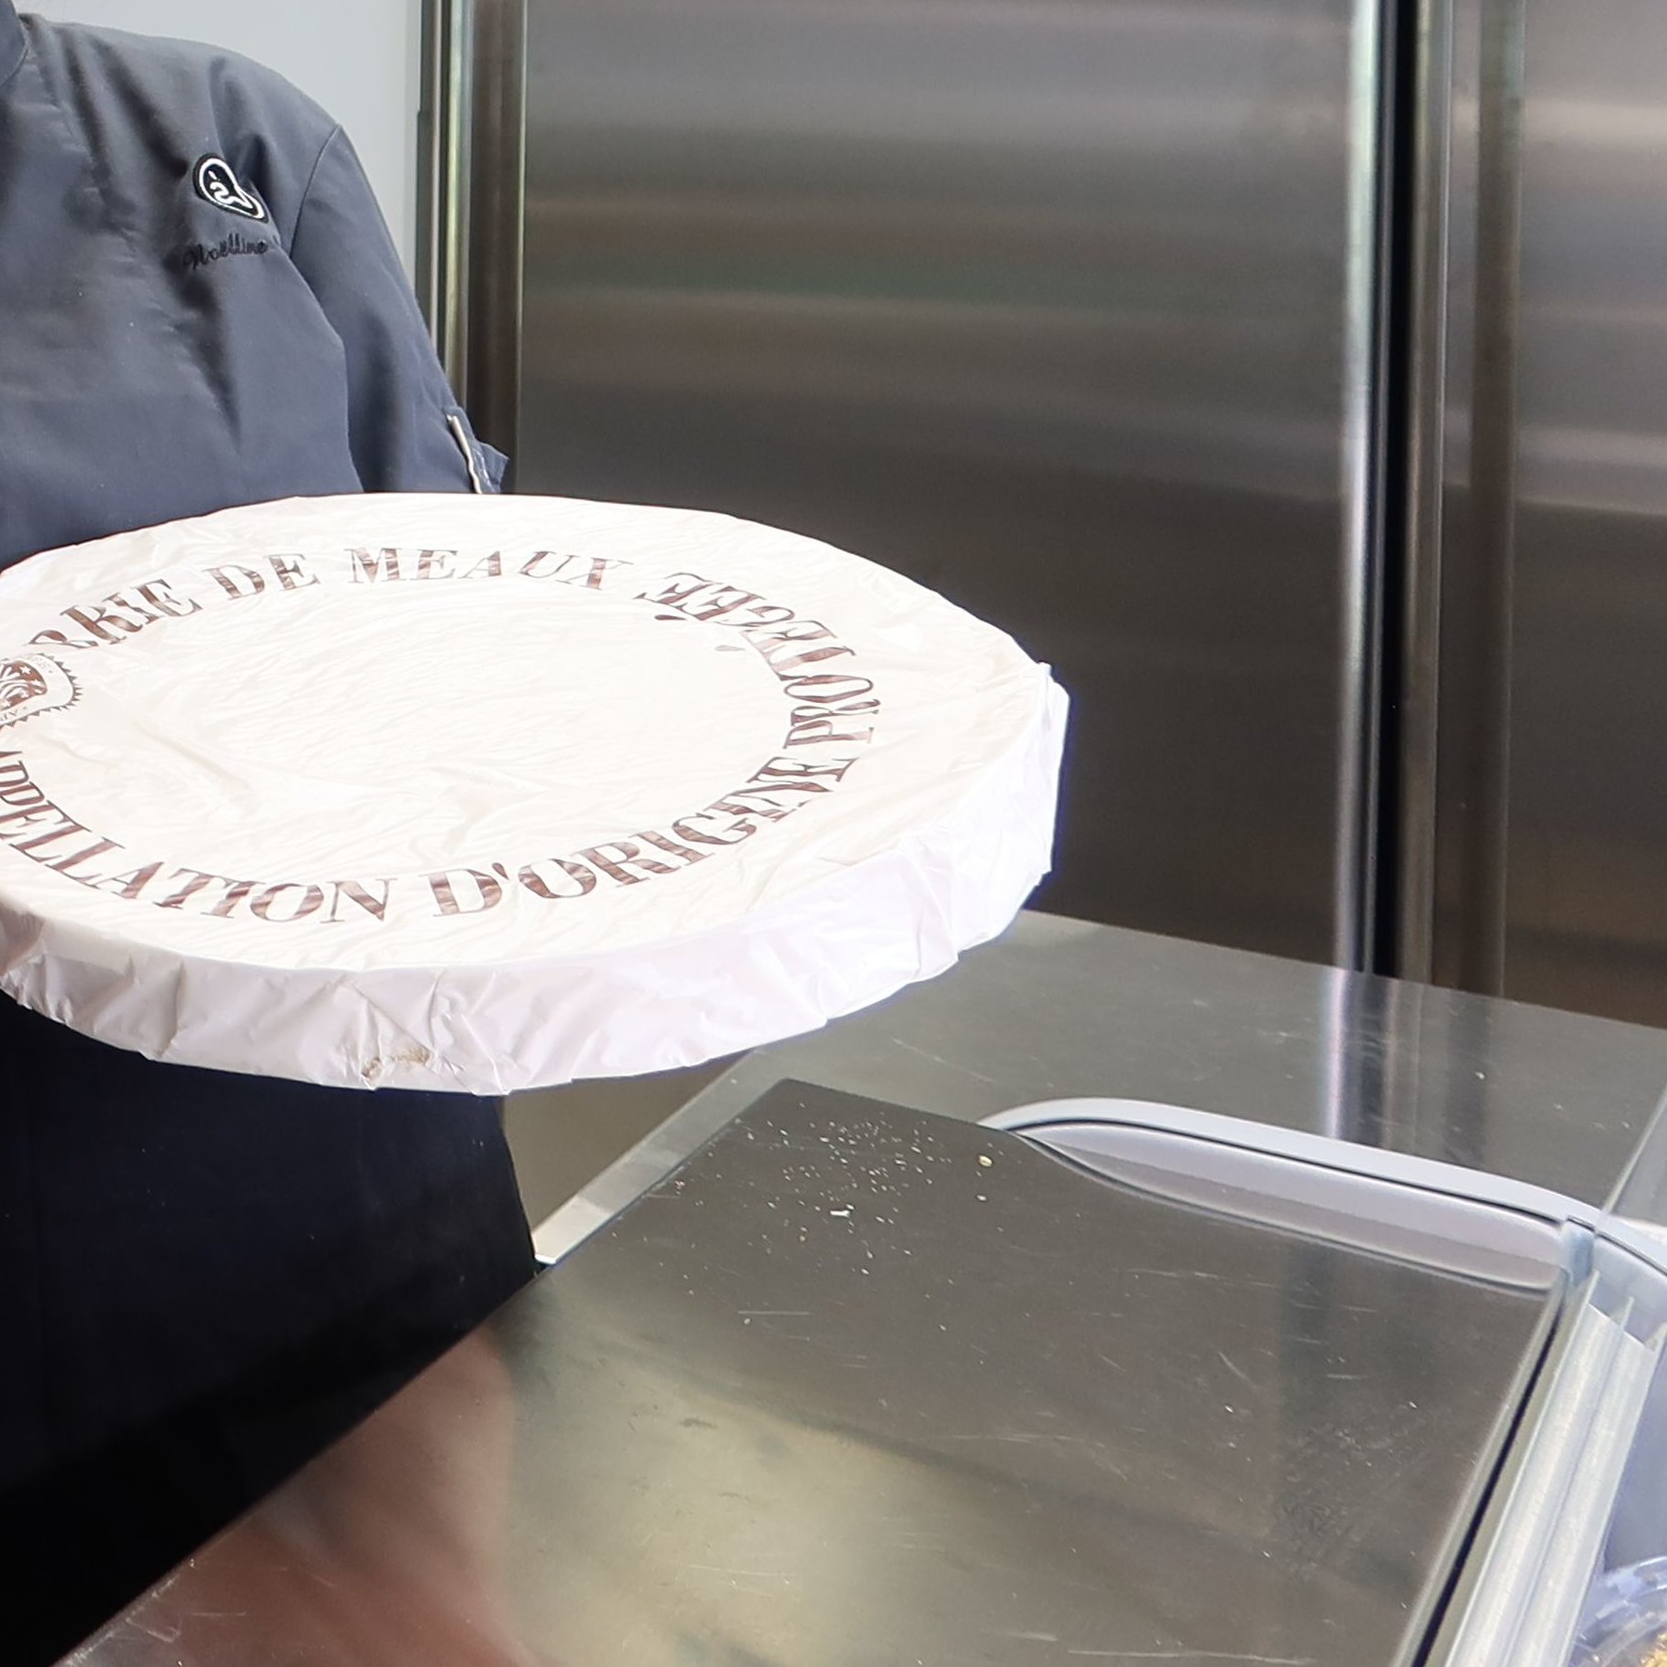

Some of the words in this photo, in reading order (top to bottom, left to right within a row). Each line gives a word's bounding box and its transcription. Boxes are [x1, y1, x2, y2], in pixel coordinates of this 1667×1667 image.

[208, 552, 320, 602] DE
[344, 547, 634, 591] MEAUX
[420, 754, 859, 917] D'ORIGINE
